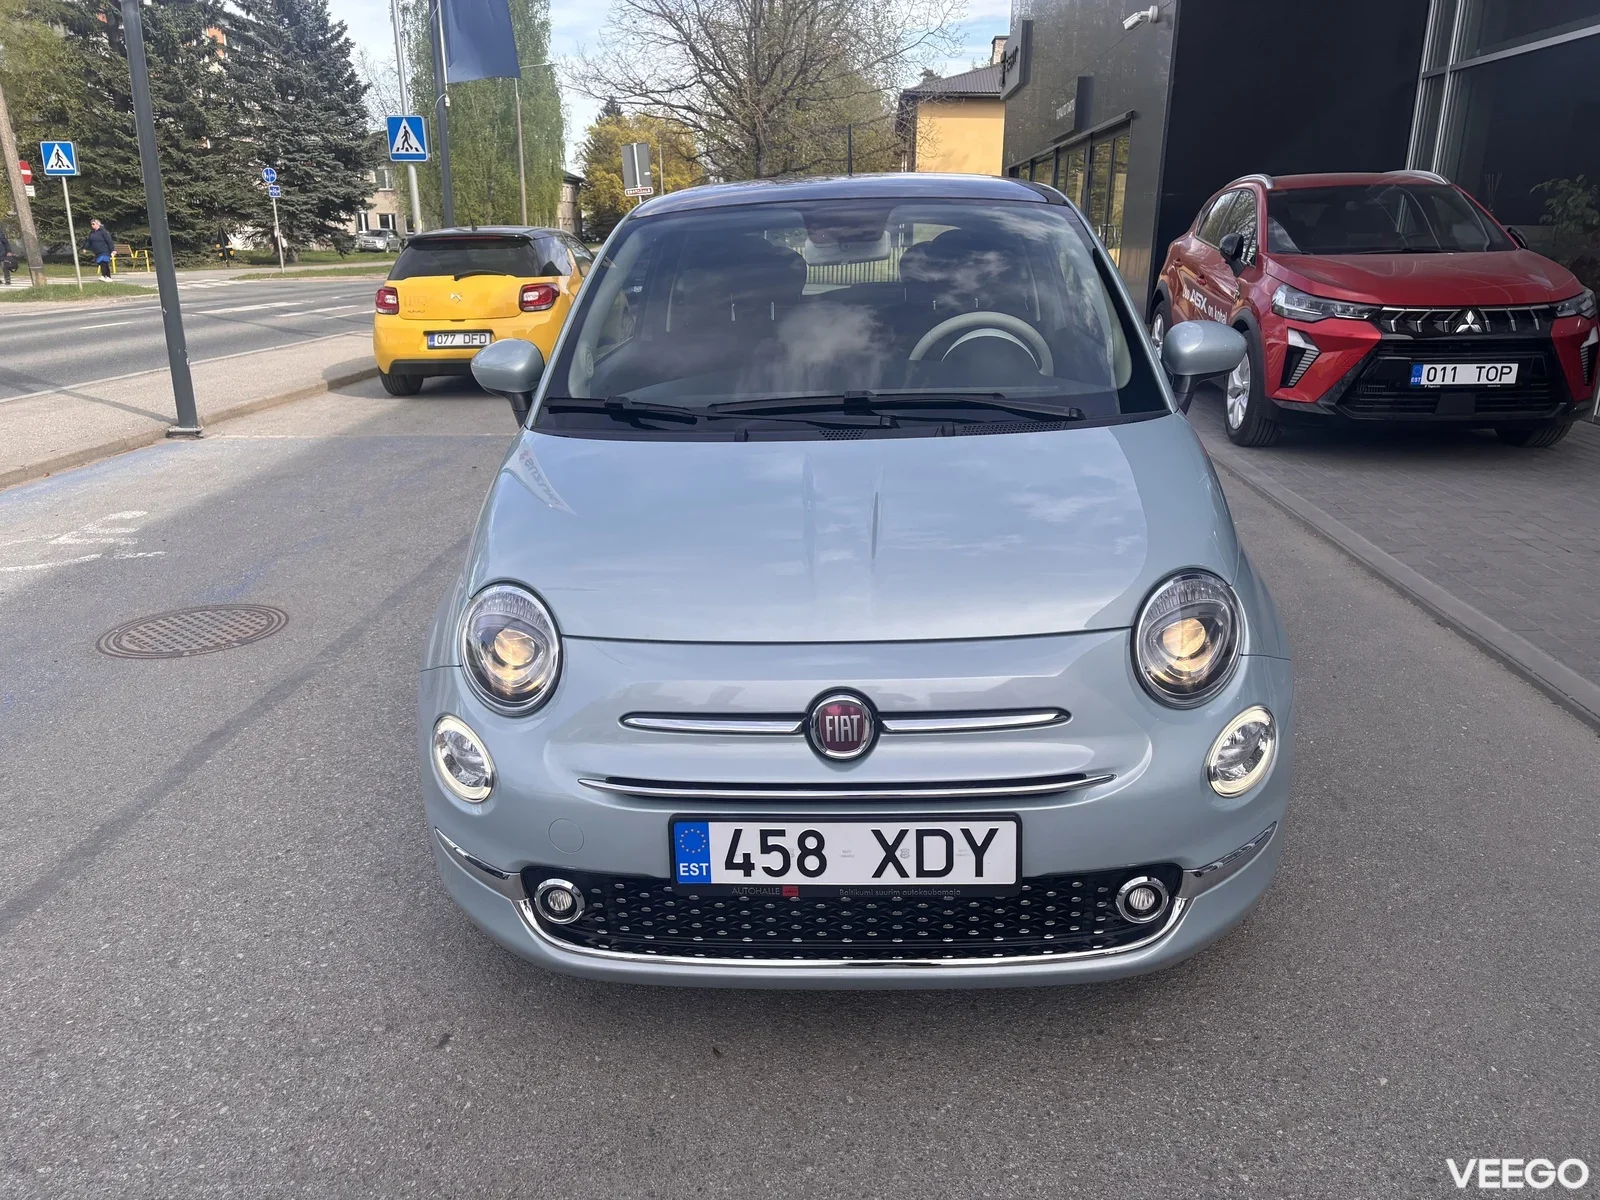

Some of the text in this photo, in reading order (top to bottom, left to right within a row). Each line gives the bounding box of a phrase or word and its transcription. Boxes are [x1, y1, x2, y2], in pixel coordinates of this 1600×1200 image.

[1190, 289, 1208, 314] ASX
[437, 334, 456, 345] 077
[463, 334, 487, 345] DFD
[1426, 365, 1513, 383] 011 TOP
[825, 714, 861, 743] FIAT
[724, 827, 1000, 879] 458 XDY
[679, 863, 709, 876] EST
[731, 887, 780, 895] AUTOHALLE
[839, 888, 873, 896] Baltikumi
[902, 888, 961, 898] autokaubamaja
